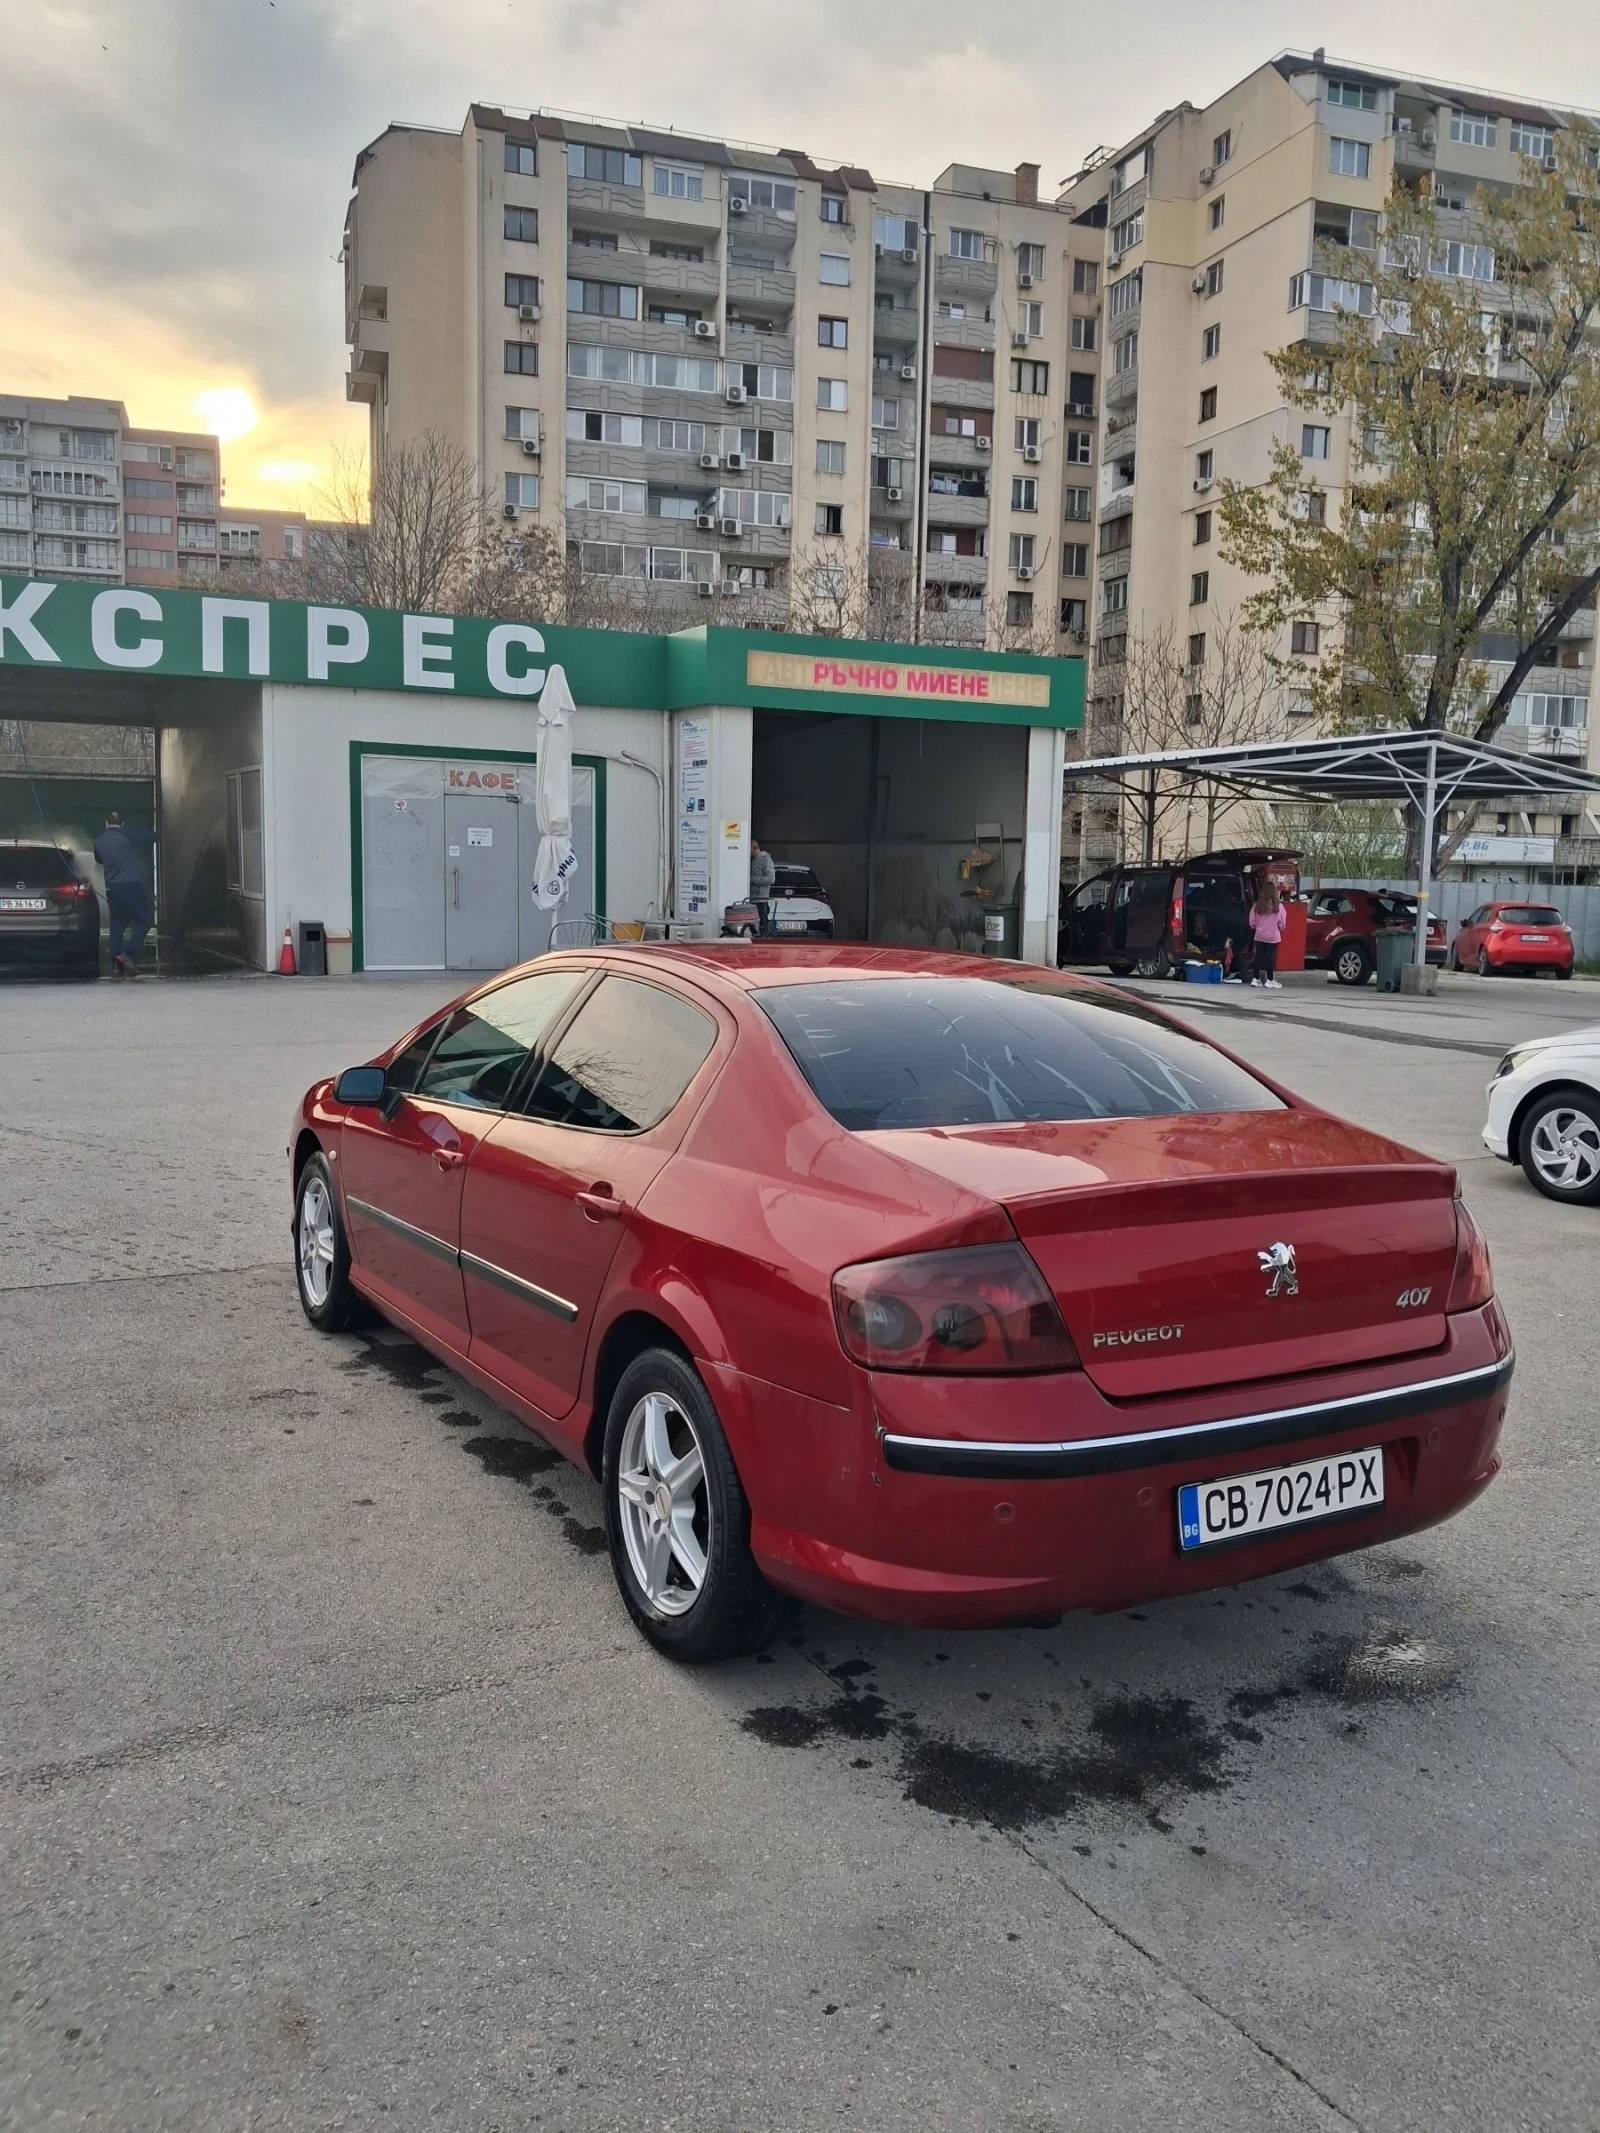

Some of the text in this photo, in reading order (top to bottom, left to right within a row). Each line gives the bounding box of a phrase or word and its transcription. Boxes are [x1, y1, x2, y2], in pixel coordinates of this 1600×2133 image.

[0, 579, 546, 696] КСПРЕС
[814, 662, 989, 698] РЪЧНО МИЕНЕ
[449, 770, 515, 790] КАФЕ
[1396, 1286, 1433, 1308] 407
[1092, 1324, 1185, 1347] PEUGEOT
[1184, 1523, 1199, 1538] BG
